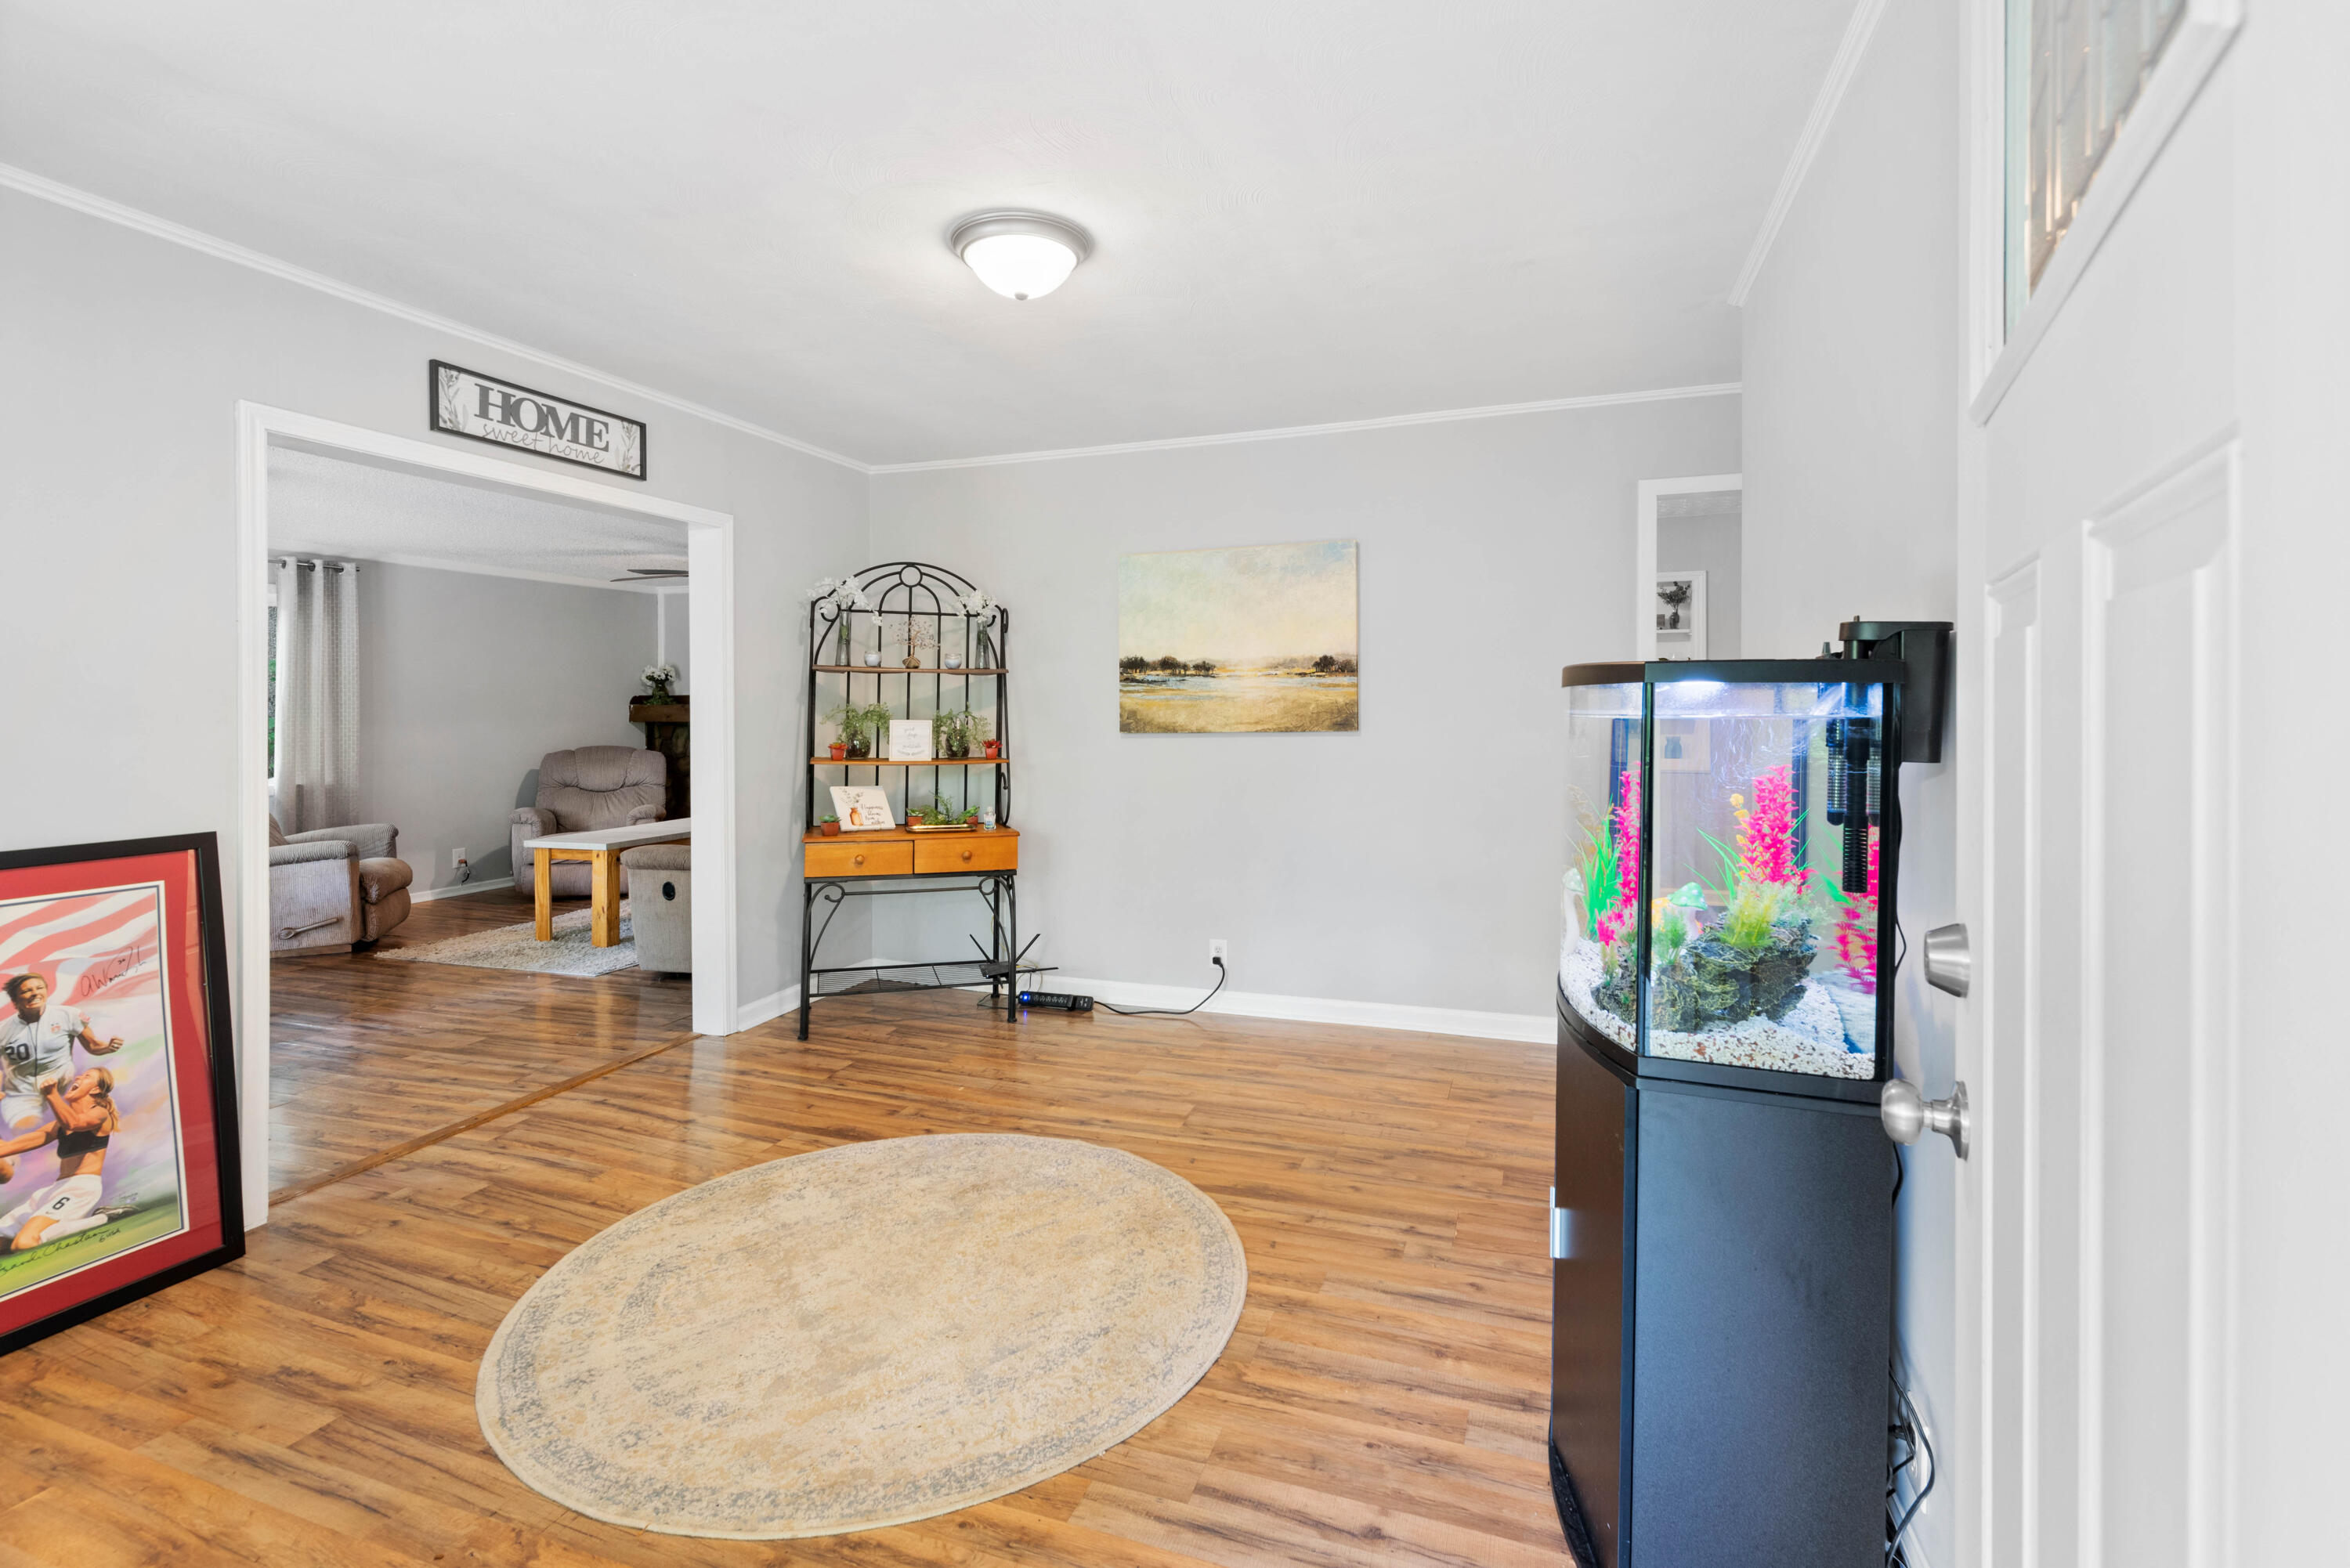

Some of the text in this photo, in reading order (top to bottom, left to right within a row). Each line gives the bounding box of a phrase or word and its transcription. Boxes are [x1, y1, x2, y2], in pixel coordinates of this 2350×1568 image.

[474, 383, 609, 452] HOME
[483, 423, 606, 464] sweet home
[5, 1042, 31, 1060] 20
[52, 1197, 70, 1211] 6
